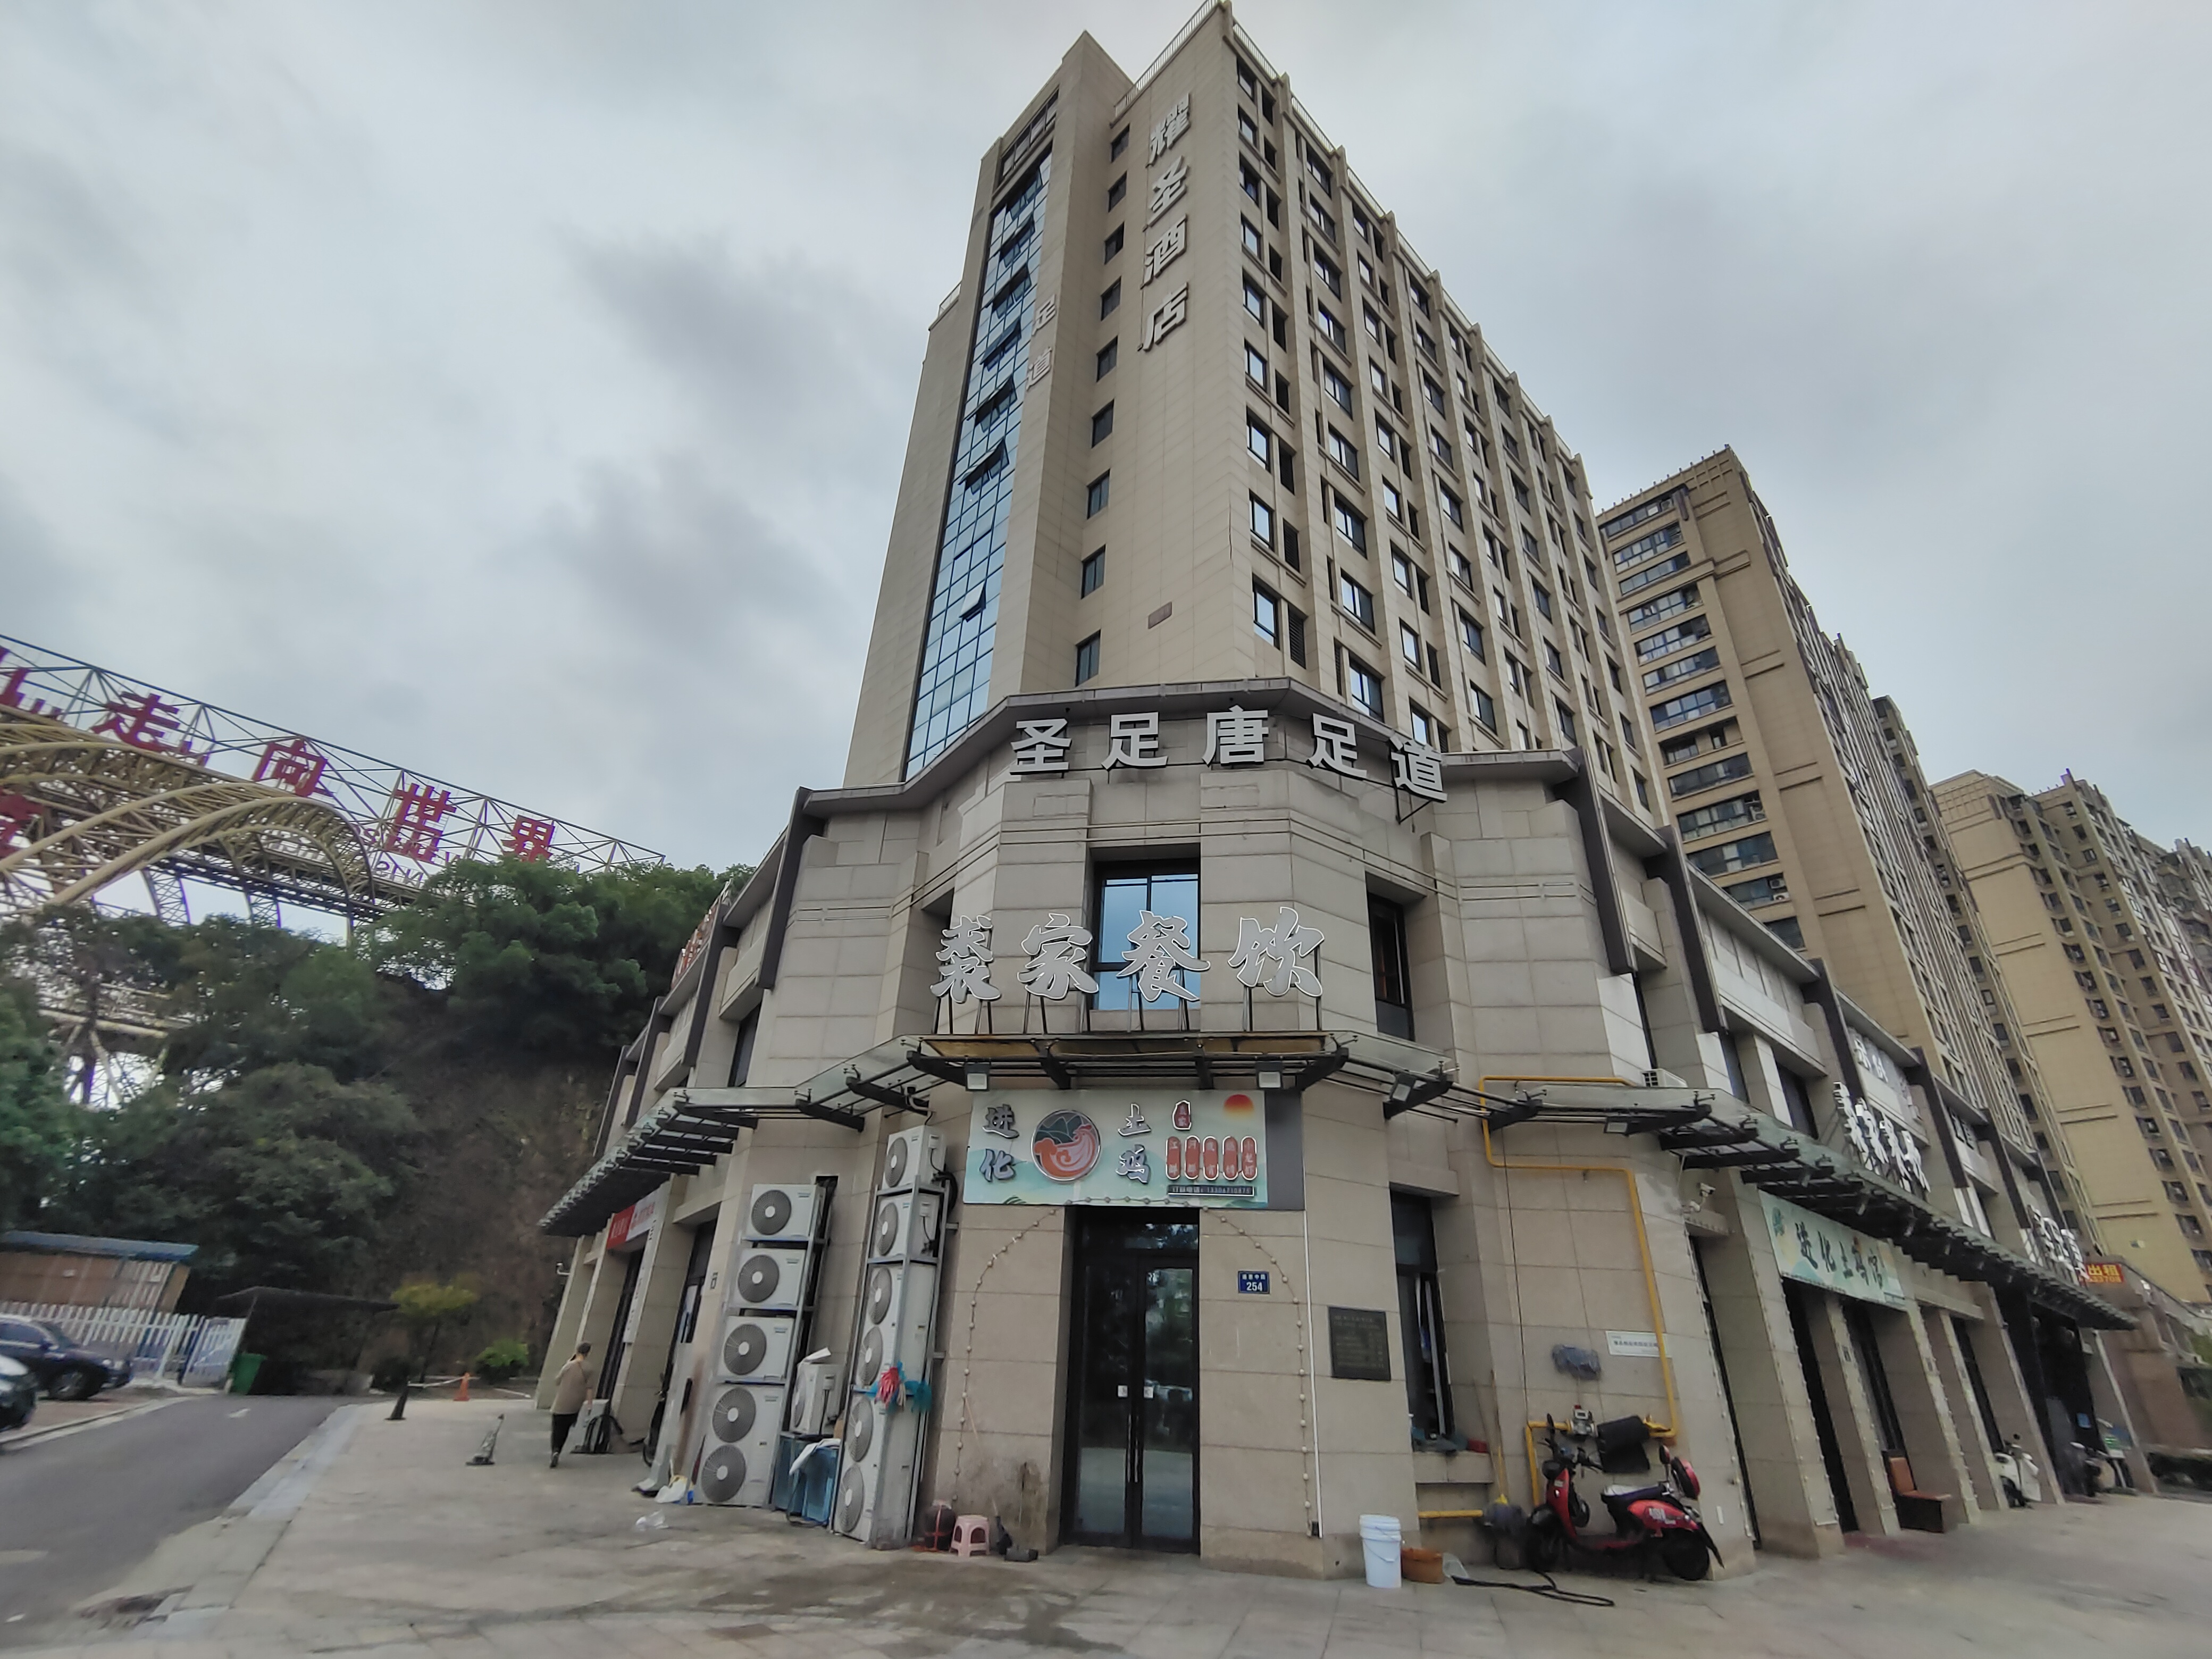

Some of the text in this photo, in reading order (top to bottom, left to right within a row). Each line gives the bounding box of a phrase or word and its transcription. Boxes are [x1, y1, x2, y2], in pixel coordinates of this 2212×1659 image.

[1026, 294, 1057, 391] 足道
[1009, 705, 1448, 802] 圣足唐足道
[1246, 1281, 1263, 1292] 254
